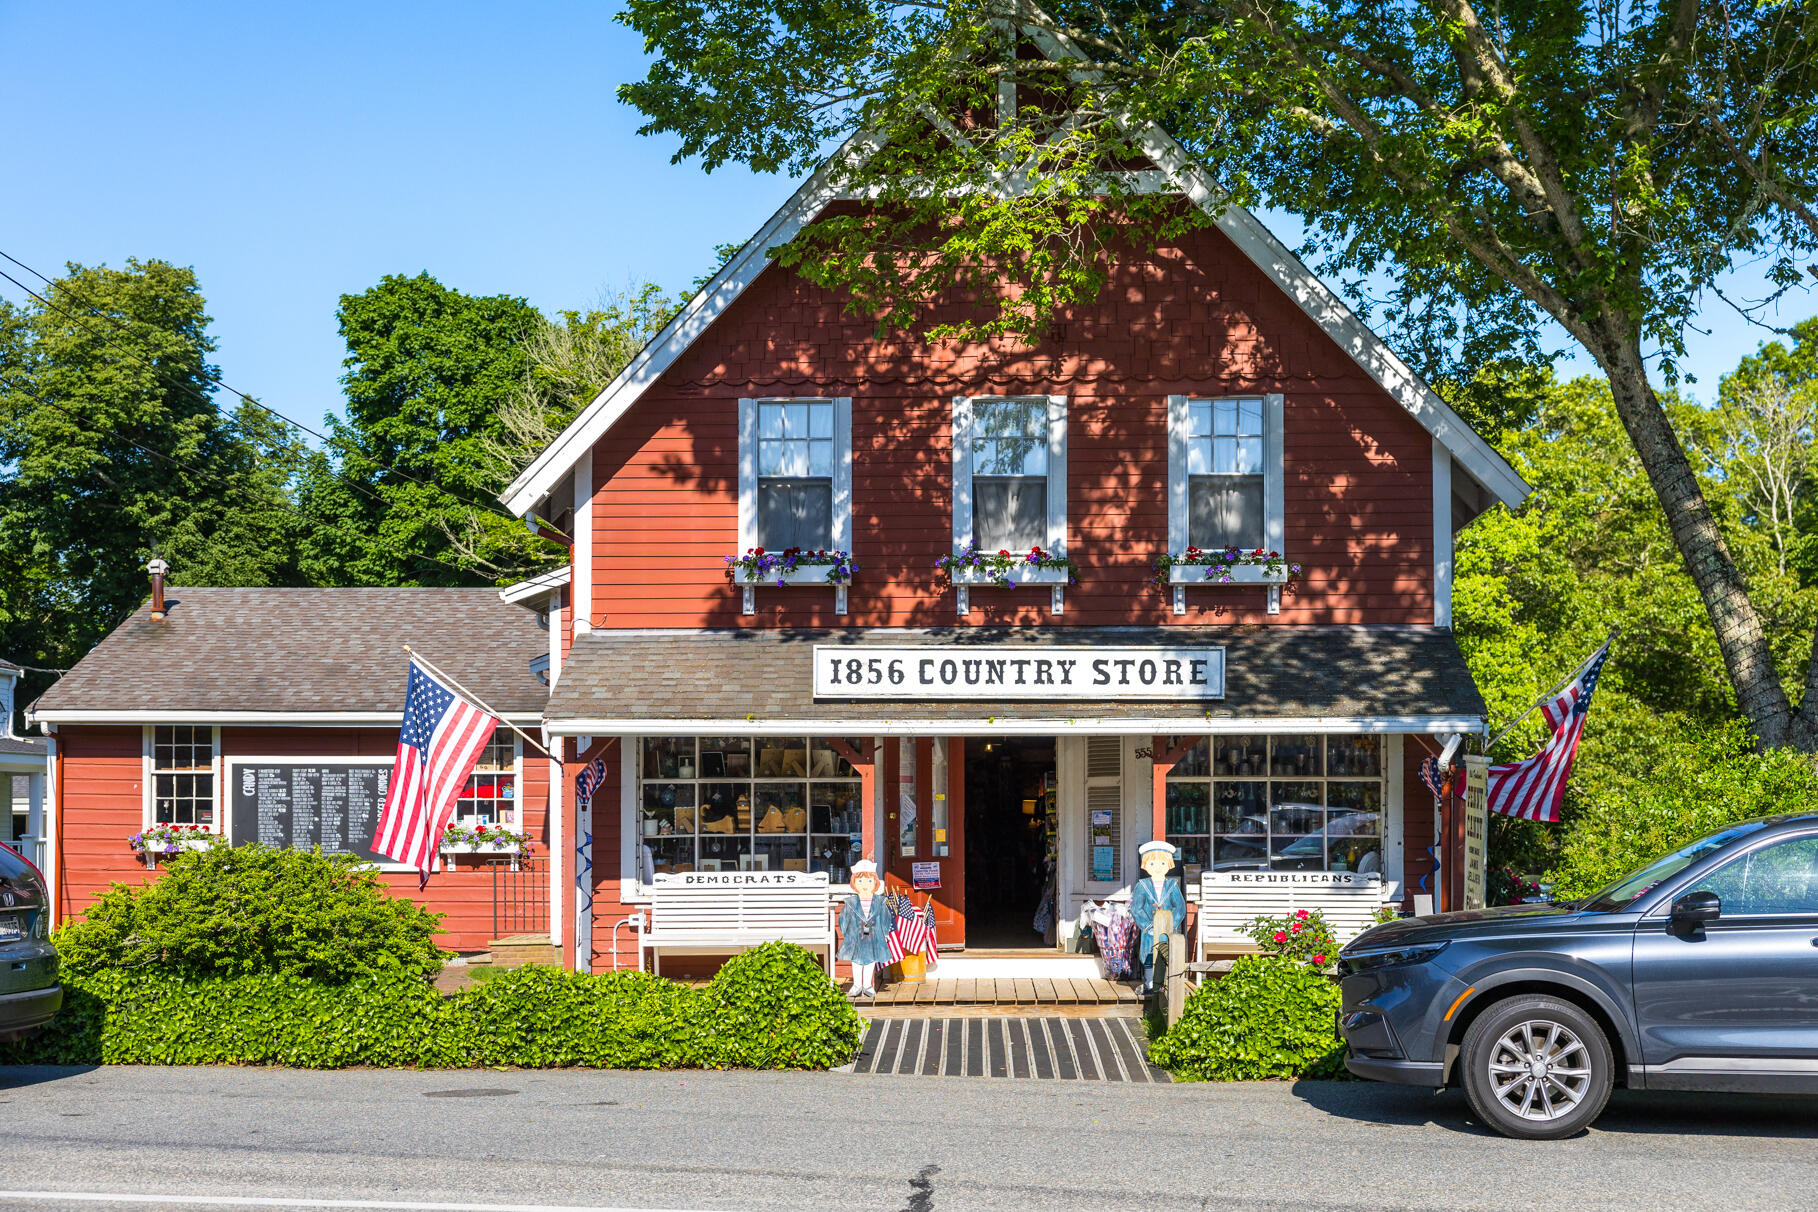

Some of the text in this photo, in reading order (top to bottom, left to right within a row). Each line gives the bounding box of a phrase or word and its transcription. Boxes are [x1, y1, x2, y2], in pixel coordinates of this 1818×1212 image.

[830, 658, 1209, 686] 1856 COUNTRY STORE
[1135, 746, 1152, 759] 555
[242, 768, 256, 797] CANDY
[686, 875, 797, 884] DEMOCRATS
[1231, 874, 1352, 883] REPUBLICANS
